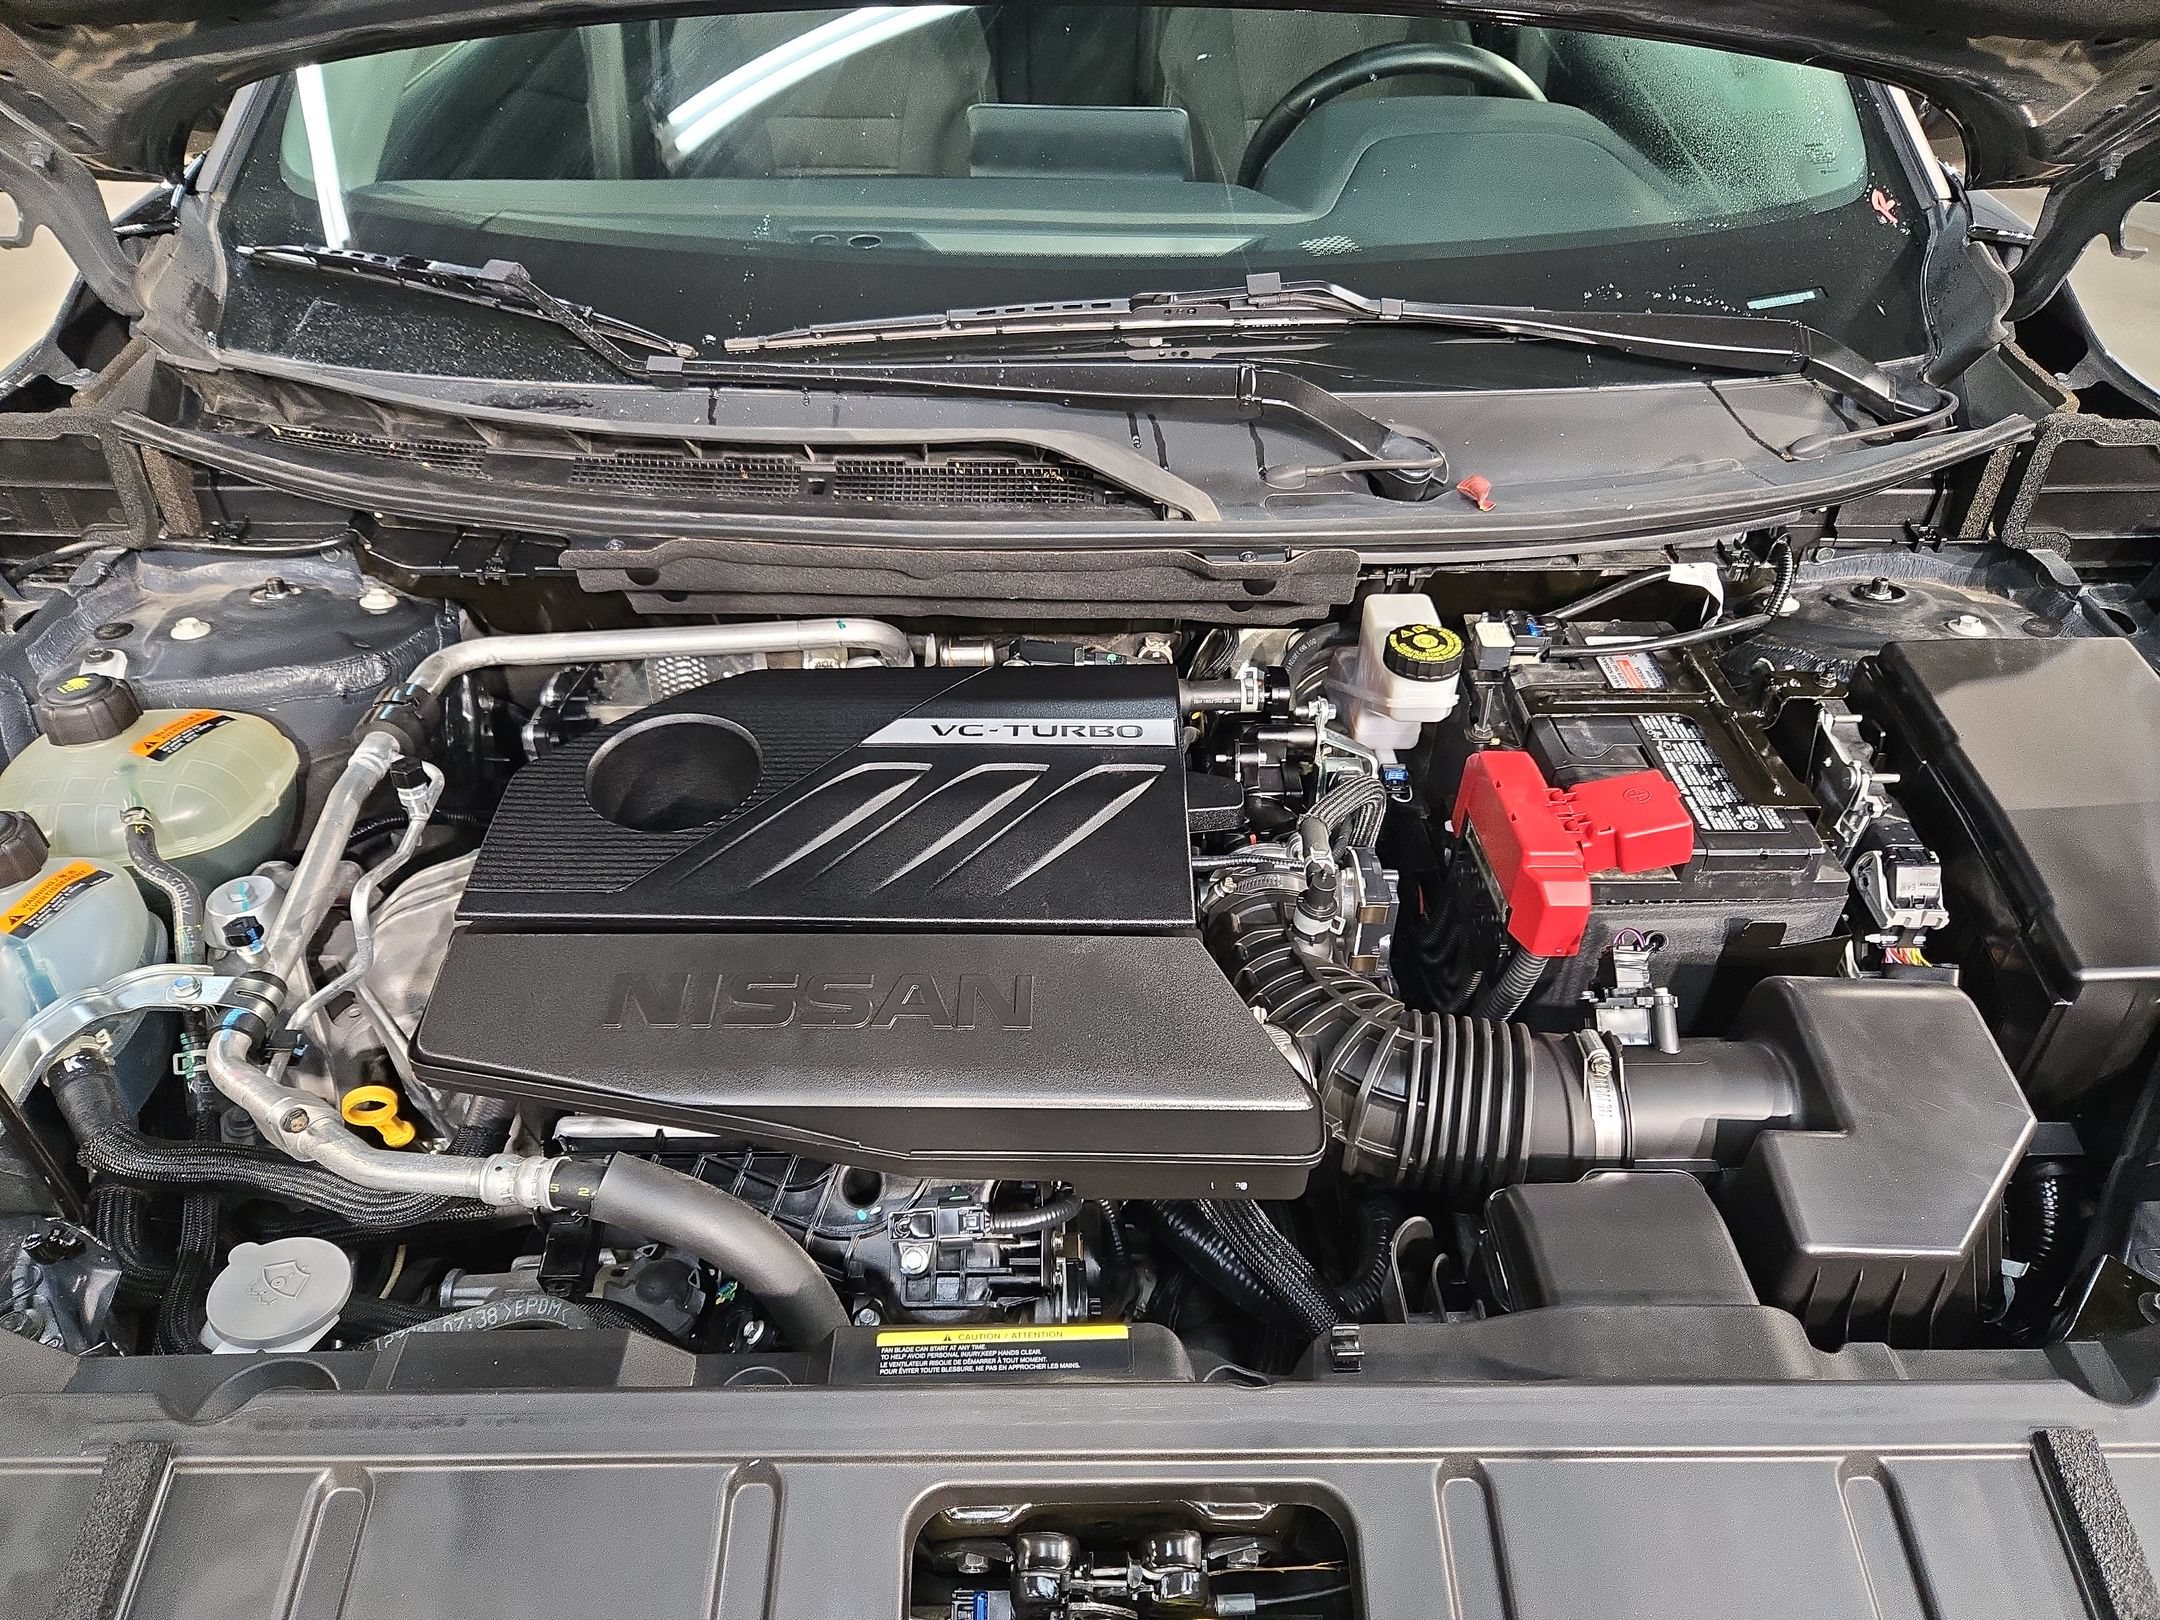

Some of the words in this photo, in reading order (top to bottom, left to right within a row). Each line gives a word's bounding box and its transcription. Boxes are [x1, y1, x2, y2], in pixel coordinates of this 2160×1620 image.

[930, 724, 1143, 738] VC-TURBO
[22, 881, 56, 909] WARNING
[28, 870, 87, 911] AVERTISSEMENT
[603, 973, 1034, 1030] NISSAN
[63, 1056, 85, 1073] K
[958, 1332, 1000, 1341] CAUTION
[1011, 1331, 1063, 1340] ATTENTION
[888, 1360, 928, 1368] VENTILATEUR
[929, 1359, 952, 1367] RISQUE
[962, 1356, 996, 1365] DÉMARRER
[927, 1351, 959, 1359] PERSONAL
[898, 1366, 920, 1374] ÉVITER
[1008, 1363, 1047, 1371] APPROCHER
